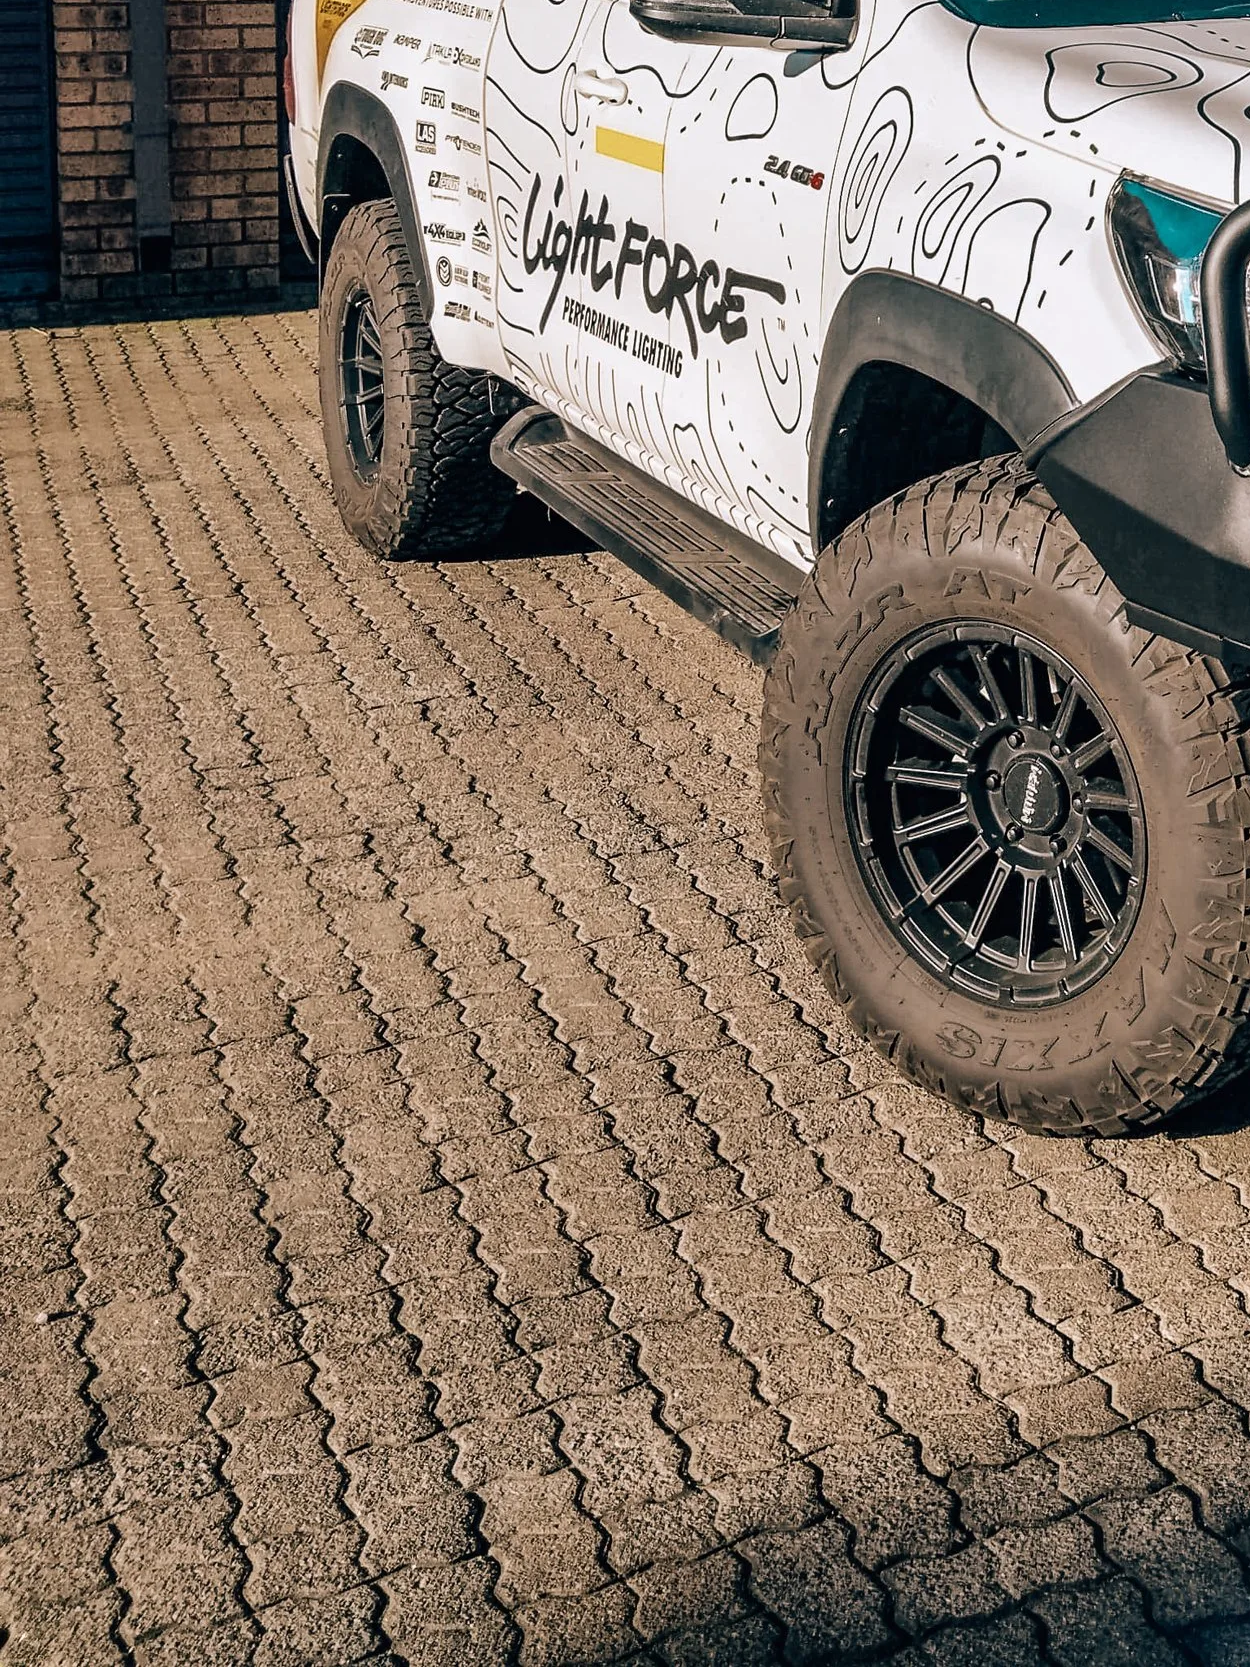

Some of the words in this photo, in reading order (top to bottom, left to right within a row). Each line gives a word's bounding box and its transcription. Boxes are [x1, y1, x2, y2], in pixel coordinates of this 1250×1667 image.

[443, 0, 474, 19] POSSIBLE
[474, 6, 494, 23] WITH
[562, 295, 629, 353] PERFORMANCE
[631, 329, 683, 379] LIGHTING
